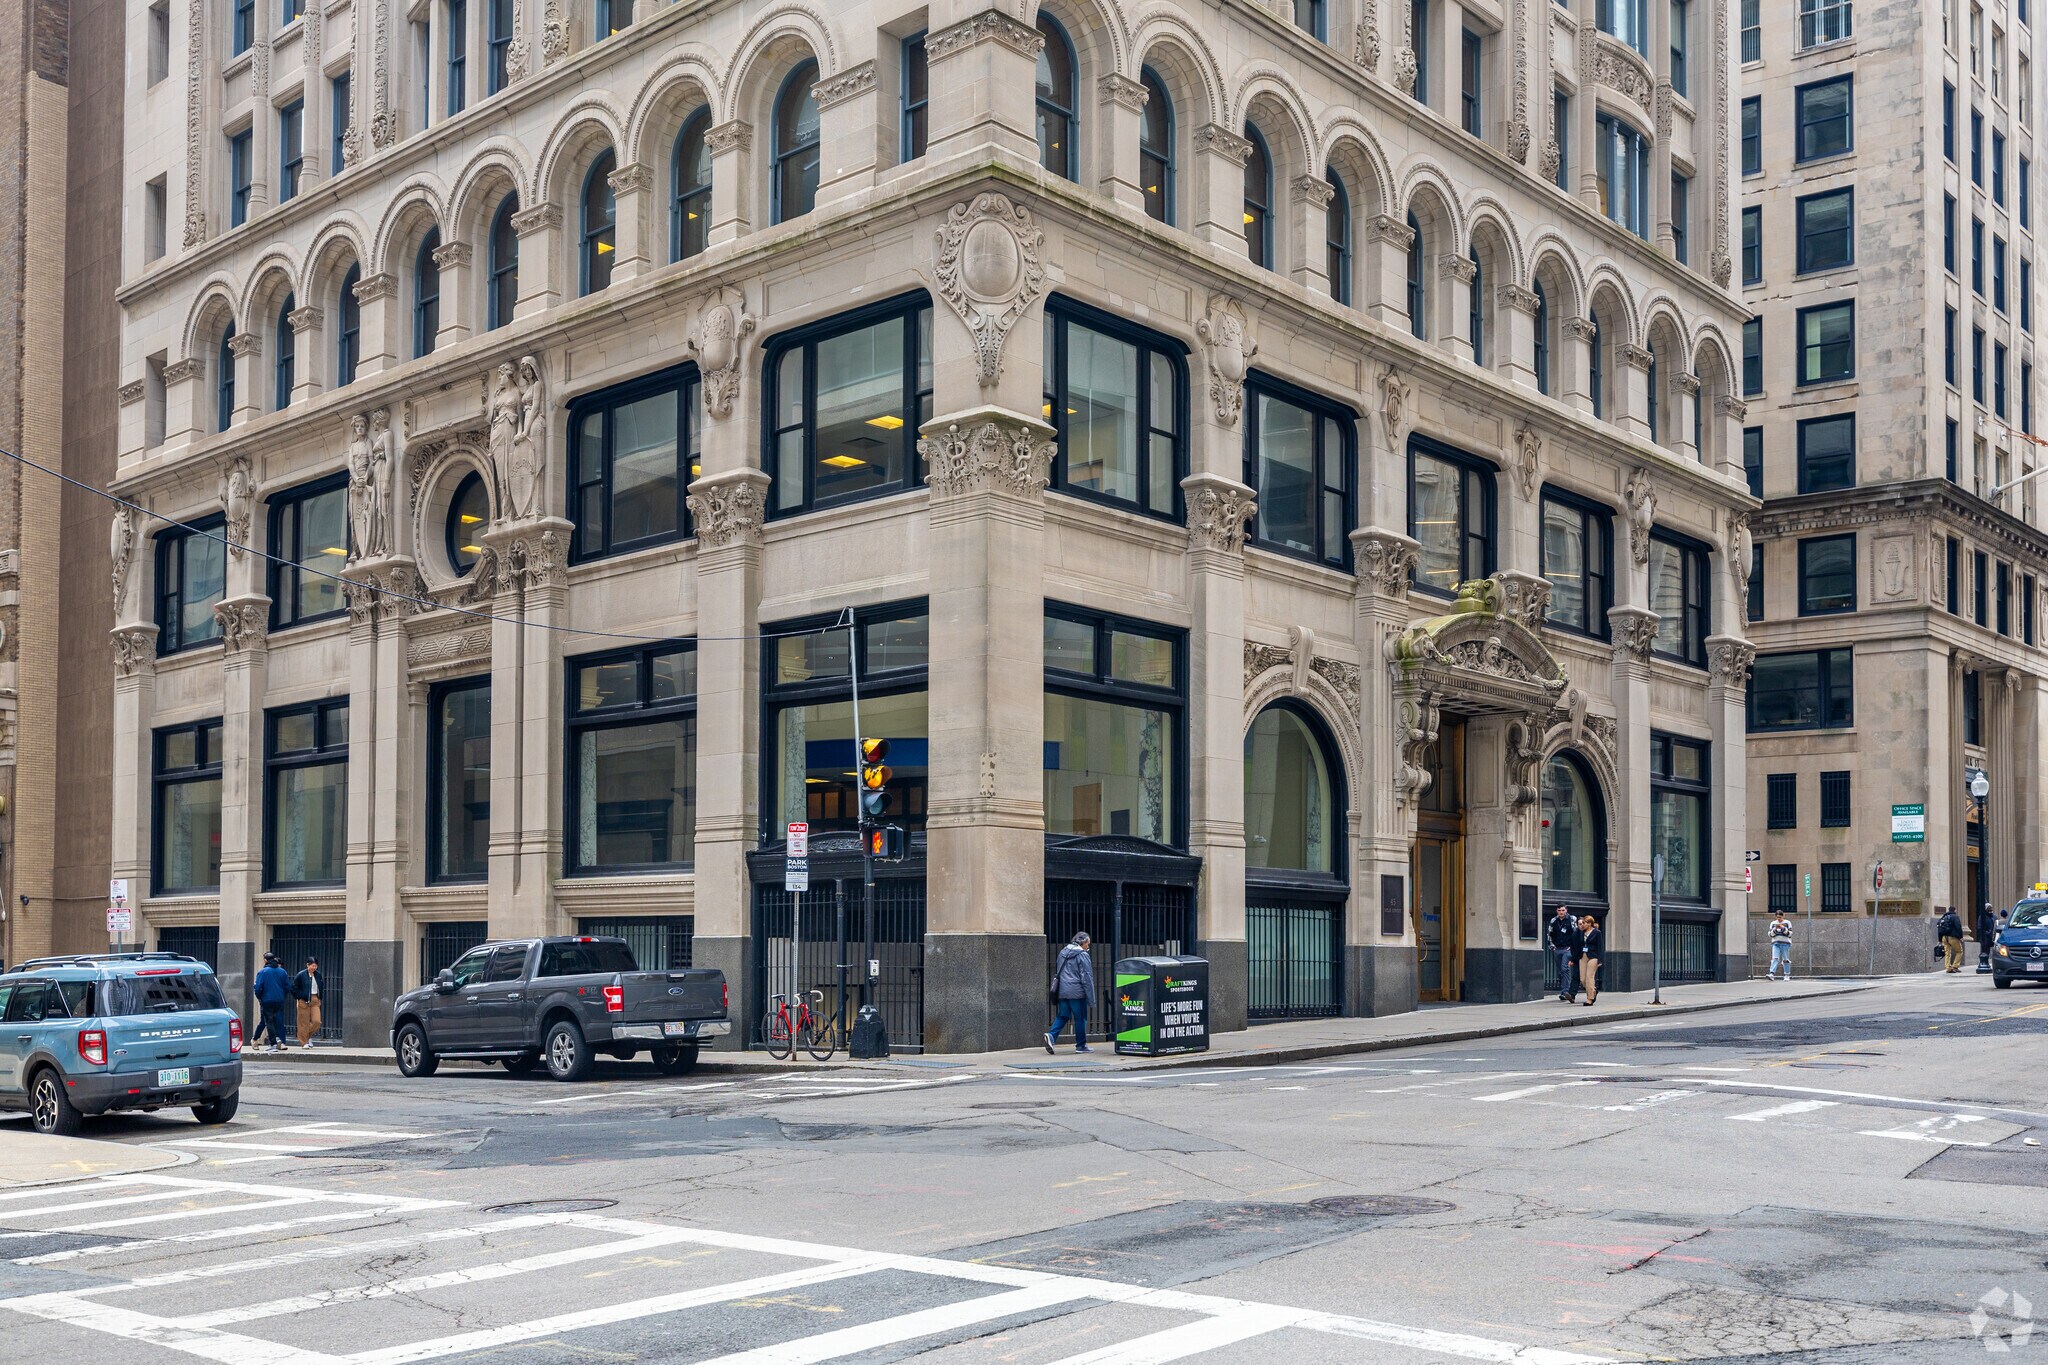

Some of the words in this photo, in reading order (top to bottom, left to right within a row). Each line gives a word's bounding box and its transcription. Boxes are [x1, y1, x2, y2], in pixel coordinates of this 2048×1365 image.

[1165, 980, 1197, 988] DRAFTKINGS
[1160, 1002, 1177, 1013] LIFE'S
[1177, 1001, 1193, 1012] MORE
[1193, 1000, 1203, 1011] FUN
[1164, 1014, 1181, 1025] WHEN
[1181, 1013, 1200, 1024] YOU'RE
[140, 1028, 201, 1037] BRONCO
[1160, 1028, 1166, 1039] IN
[1167, 1027, 1175, 1038] ON
[1175, 1026, 1185, 1037] THE
[1186, 1025, 1204, 1036] ACTION
[160, 1072, 171, 1082] 310
